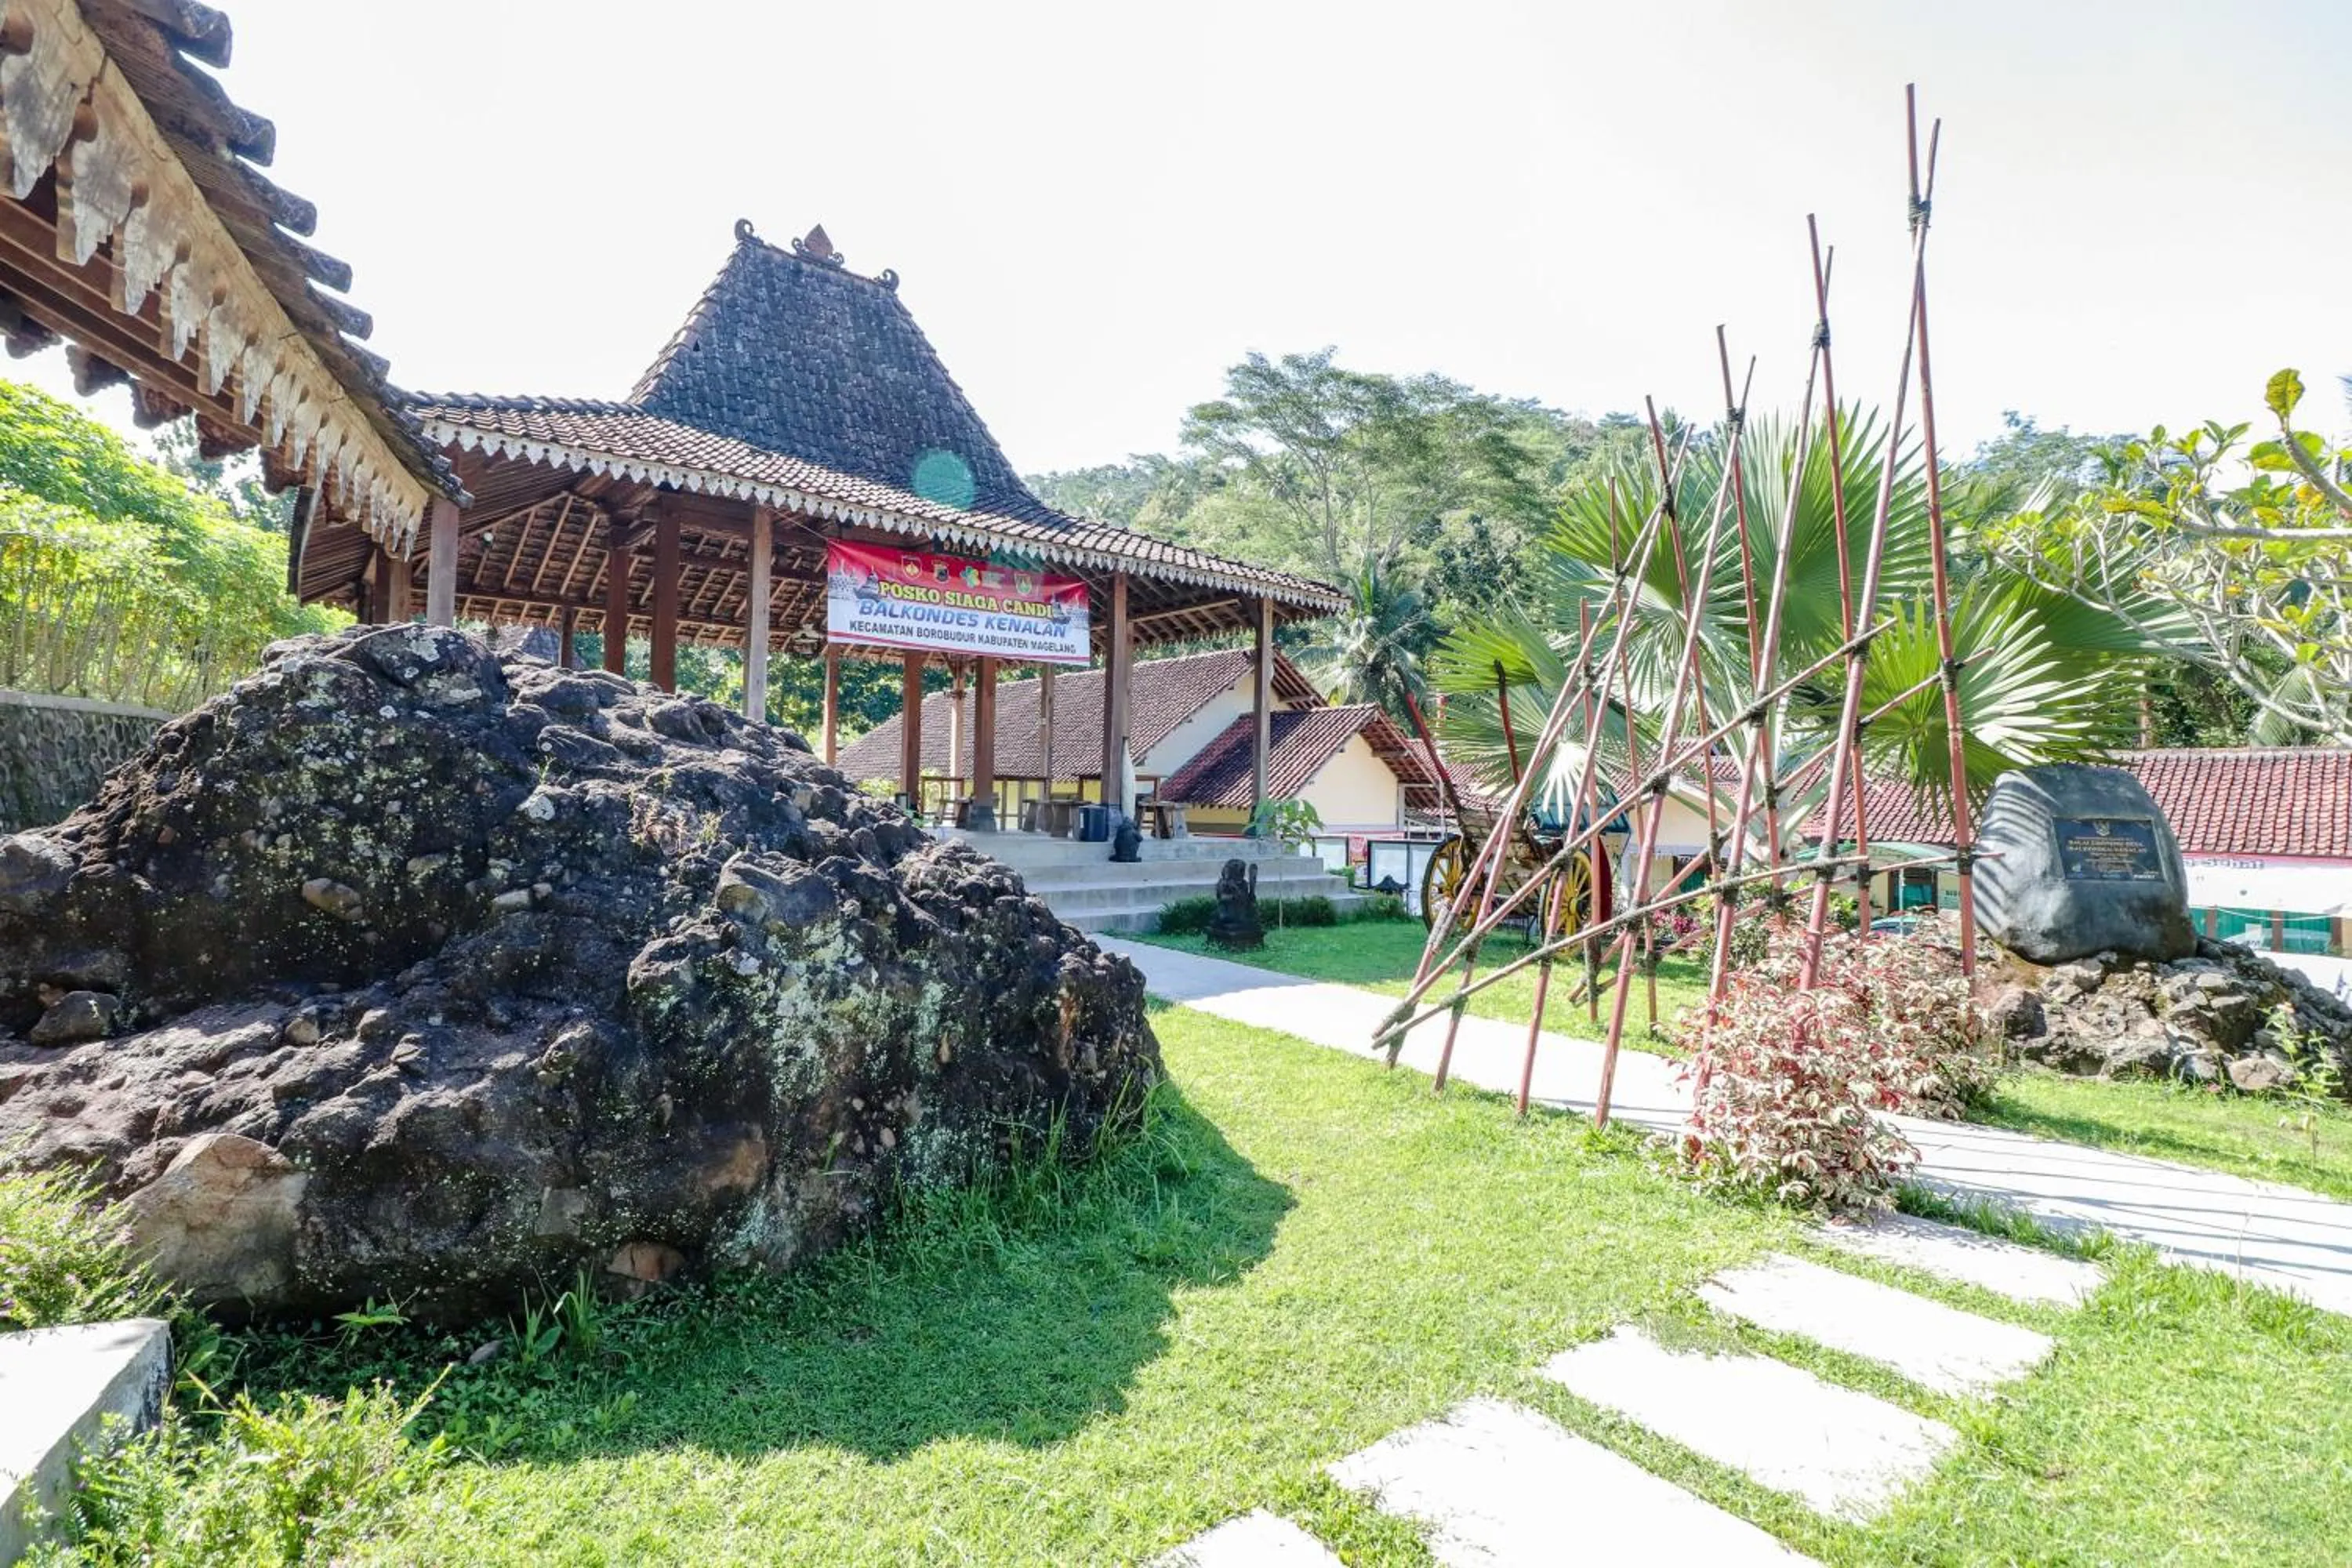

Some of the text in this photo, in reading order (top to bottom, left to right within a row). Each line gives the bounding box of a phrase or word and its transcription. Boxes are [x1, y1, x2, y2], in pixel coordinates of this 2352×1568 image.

[858, 600, 1067, 638] BALKONDES KENALAN
[880, 582, 1053, 619] POSKO SIAGA CANDI
[849, 620, 1076, 654] KECAMATAN BOROBUDUR KABUPATEN MAGELANG
